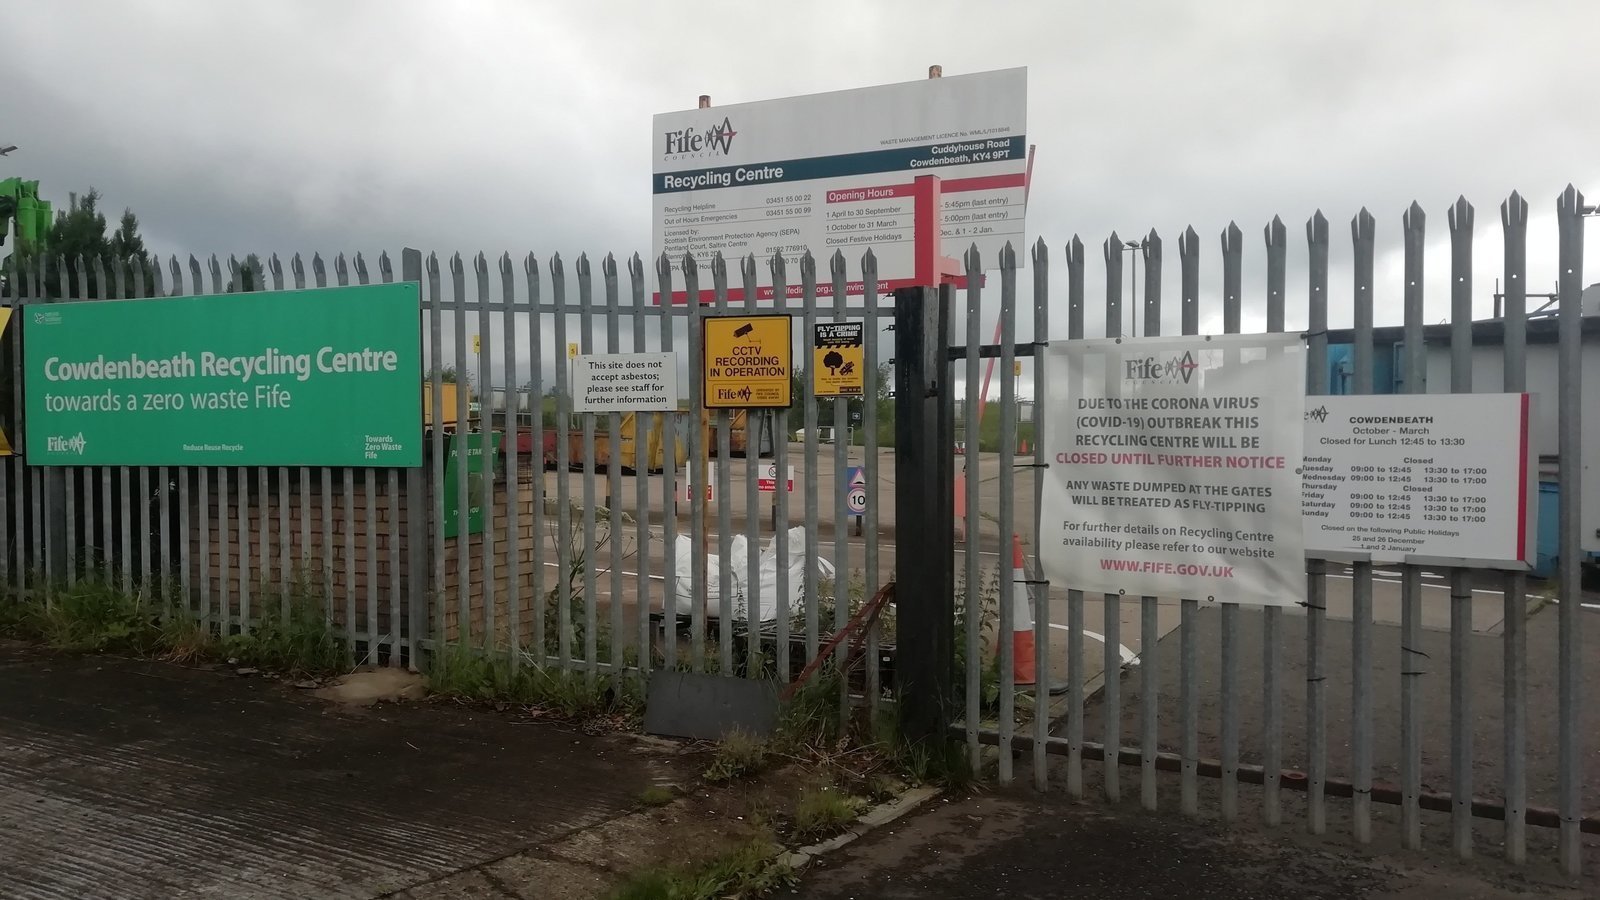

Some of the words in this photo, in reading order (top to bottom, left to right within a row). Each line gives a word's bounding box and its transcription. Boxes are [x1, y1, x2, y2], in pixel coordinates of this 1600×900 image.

[664, 127, 702, 154] Fife
[932, 142, 984, 154] Cuddyhouse
[986, 139, 1010, 148] Road
[664, 151, 720, 162] COUNCIL
[910, 156, 970, 168] Cowdenbeath,
[972, 152, 990, 160] KY4
[992, 150, 1010, 159] 9PT
[664, 172, 731, 189] Recycling
[735, 166, 784, 182] Centre
[828, 190, 865, 202] Opening
[868, 188, 894, 198] Hours
[944, 200, 971, 208] 5:45pm
[972, 199, 986, 208] (last
[988, 197, 1008, 206] entry)
[664, 204, 692, 214] Recycling
[692, 203, 716, 211] Helpline
[831, 210, 846, 218] April
[866, 206, 901, 216] September
[682, 216, 700, 224] Hours
[700, 214, 738, 222] Emergencies
[832, 222, 857, 231] October
[876, 220, 897, 228] March
[724, 232, 754, 240] Protection
[826, 236, 848, 244] Closed
[850, 235, 872, 243] Festive
[874, 233, 902, 242] Holidays
[818, 324, 861, 332] FLY-TIPPING
[732, 346, 762, 356] CCTV
[44, 352, 196, 382] Cowdenbeath
[200, 348, 310, 383] Recycling
[316, 346, 398, 373] Centre
[588, 362, 606, 370] This
[608, 361, 624, 369] site
[626, 360, 645, 369] does
[716, 356, 779, 366] RECORDING
[710, 368, 720, 377] IN
[724, 367, 785, 377] OPERATION
[1126, 356, 1162, 380] Fife
[592, 374, 619, 382] accept
[621, 372, 660, 381] asbestos;
[587, 384, 613, 394] please
[632, 384, 650, 392] staff
[652, 383, 664, 392] for
[718, 388, 736, 400] Fife
[45, 388, 121, 412] towards
[126, 394, 137, 411] a
[143, 392, 184, 411] zero
[190, 389, 248, 410] waste
[255, 384, 290, 408] Fife
[584, 396, 614, 404] further
[616, 395, 667, 404] information
[1078, 398, 1105, 410] DUE
[1106, 398, 1122, 410] TO
[1125, 398, 1148, 410] THE
[1152, 397, 1210, 410] CORONA
[1212, 396, 1260, 409] VIRUS
[1076, 416, 1145, 430] (COVID-19)
[1148, 416, 1222, 429] OUTBREAK
[1224, 416, 1259, 429] THIS
[1349, 416, 1434, 424] COWDENBEATH
[1352, 426, 1390, 434] October
[1400, 427, 1430, 435] March
[48, 436, 68, 452] Fife
[365, 434, 393, 443] Towards
[1076, 434, 1148, 447] RECYCLING
[1150, 436, 1200, 448] CENTRE
[1202, 436, 1237, 449] WILL
[1240, 436, 1260, 448] BE
[1400, 438, 1424, 446] 12:45
[1428, 438, 1437, 446] to
[1440, 438, 1466, 446] 13:30
[222, 443, 244, 452] Recycle
[364, 443, 380, 451] Zero
[381, 442, 402, 451] Waste
[1056, 452, 1108, 465] CLOSED
[1112, 453, 1155, 466] UNTIL
[1157, 454, 1222, 468] FURTHER
[1226, 456, 1285, 469] NOTICE
[1303, 456, 1332, 464] Monday
[1066, 480, 1090, 490] ANY
[1092, 480, 1130, 492] WASTE
[1133, 482, 1186, 494] DUMPED
[1189, 484, 1202, 494] AT
[1204, 485, 1228, 496] THE
[1231, 486, 1272, 498] GATES
[852, 496, 866, 506] 10
[1072, 496, 1099, 506] WILL
[1102, 496, 1116, 507] BE
[1117, 497, 1171, 508] TREATED
[1174, 498, 1190, 510] AS
[1192, 500, 1266, 514] FLY-TIPPING
[1063, 521, 1081, 531] For
[1082, 522, 1122, 534] further
[1124, 523, 1160, 536] details
[1162, 527, 1176, 536] on
[1180, 526, 1233, 542] Recycling
[1235, 530, 1274, 543] Centre
[1321, 524, 1345, 532] Closed
[1370, 526, 1402, 534] following
[1388, 536, 1425, 544] December
[1062, 536, 1122, 551] availability
[1124, 540, 1160, 552] please
[1162, 541, 1190, 553] refer
[1192, 544, 1205, 554] to
[1208, 545, 1226, 556] our
[1230, 546, 1275, 559] website
[1100, 559, 1234, 578] WWW.FIFE.GOV.UK
